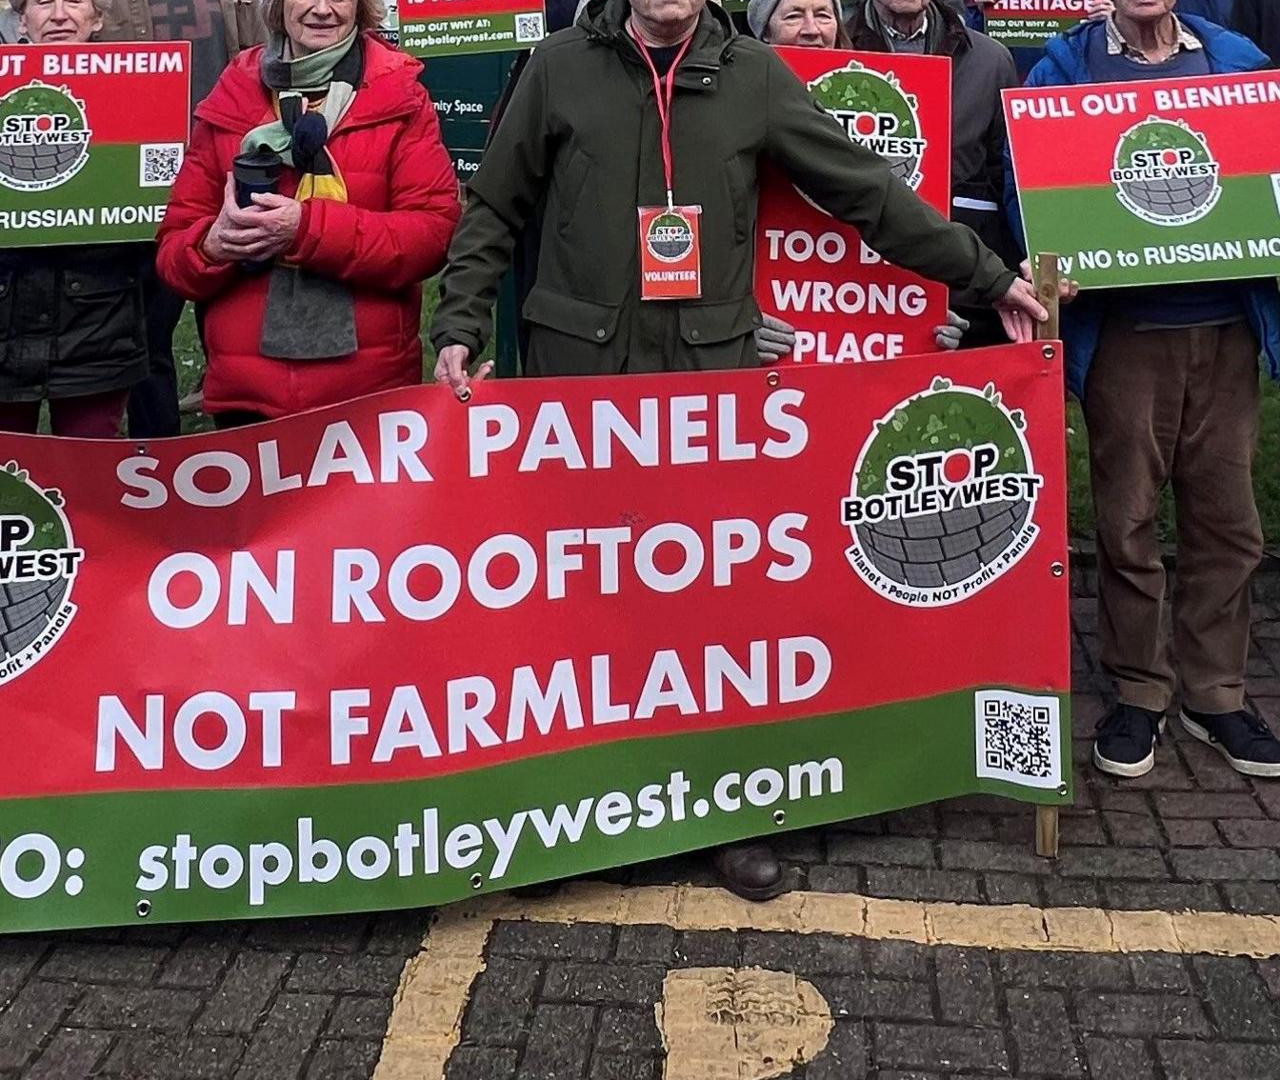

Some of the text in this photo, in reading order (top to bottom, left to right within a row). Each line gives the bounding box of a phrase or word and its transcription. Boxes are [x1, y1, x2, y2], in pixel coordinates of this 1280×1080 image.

[43, 53, 183, 73] BLENHEIM
[455, 100, 483, 114] Space
[1011, 98, 1074, 120] PULL
[1082, 94, 1137, 116] OUT
[101, 206, 166, 224] MONE
[1079, 250, 1112, 270] NO
[1117, 250, 1139, 267] to
[1145, 241, 1243, 265] RUSSIAN
[645, 271, 696, 281] VOLUNTEER
[772, 281, 928, 318] WRONG
[794, 333, 904, 364] PLACE
[117, 389, 808, 509] SOLAR PANELS
[148, 513, 811, 627] ON ROOFTOPS
[96, 636, 831, 771] NOT FARMLAND
[138, 756, 843, 905] stopbotleywest.com
